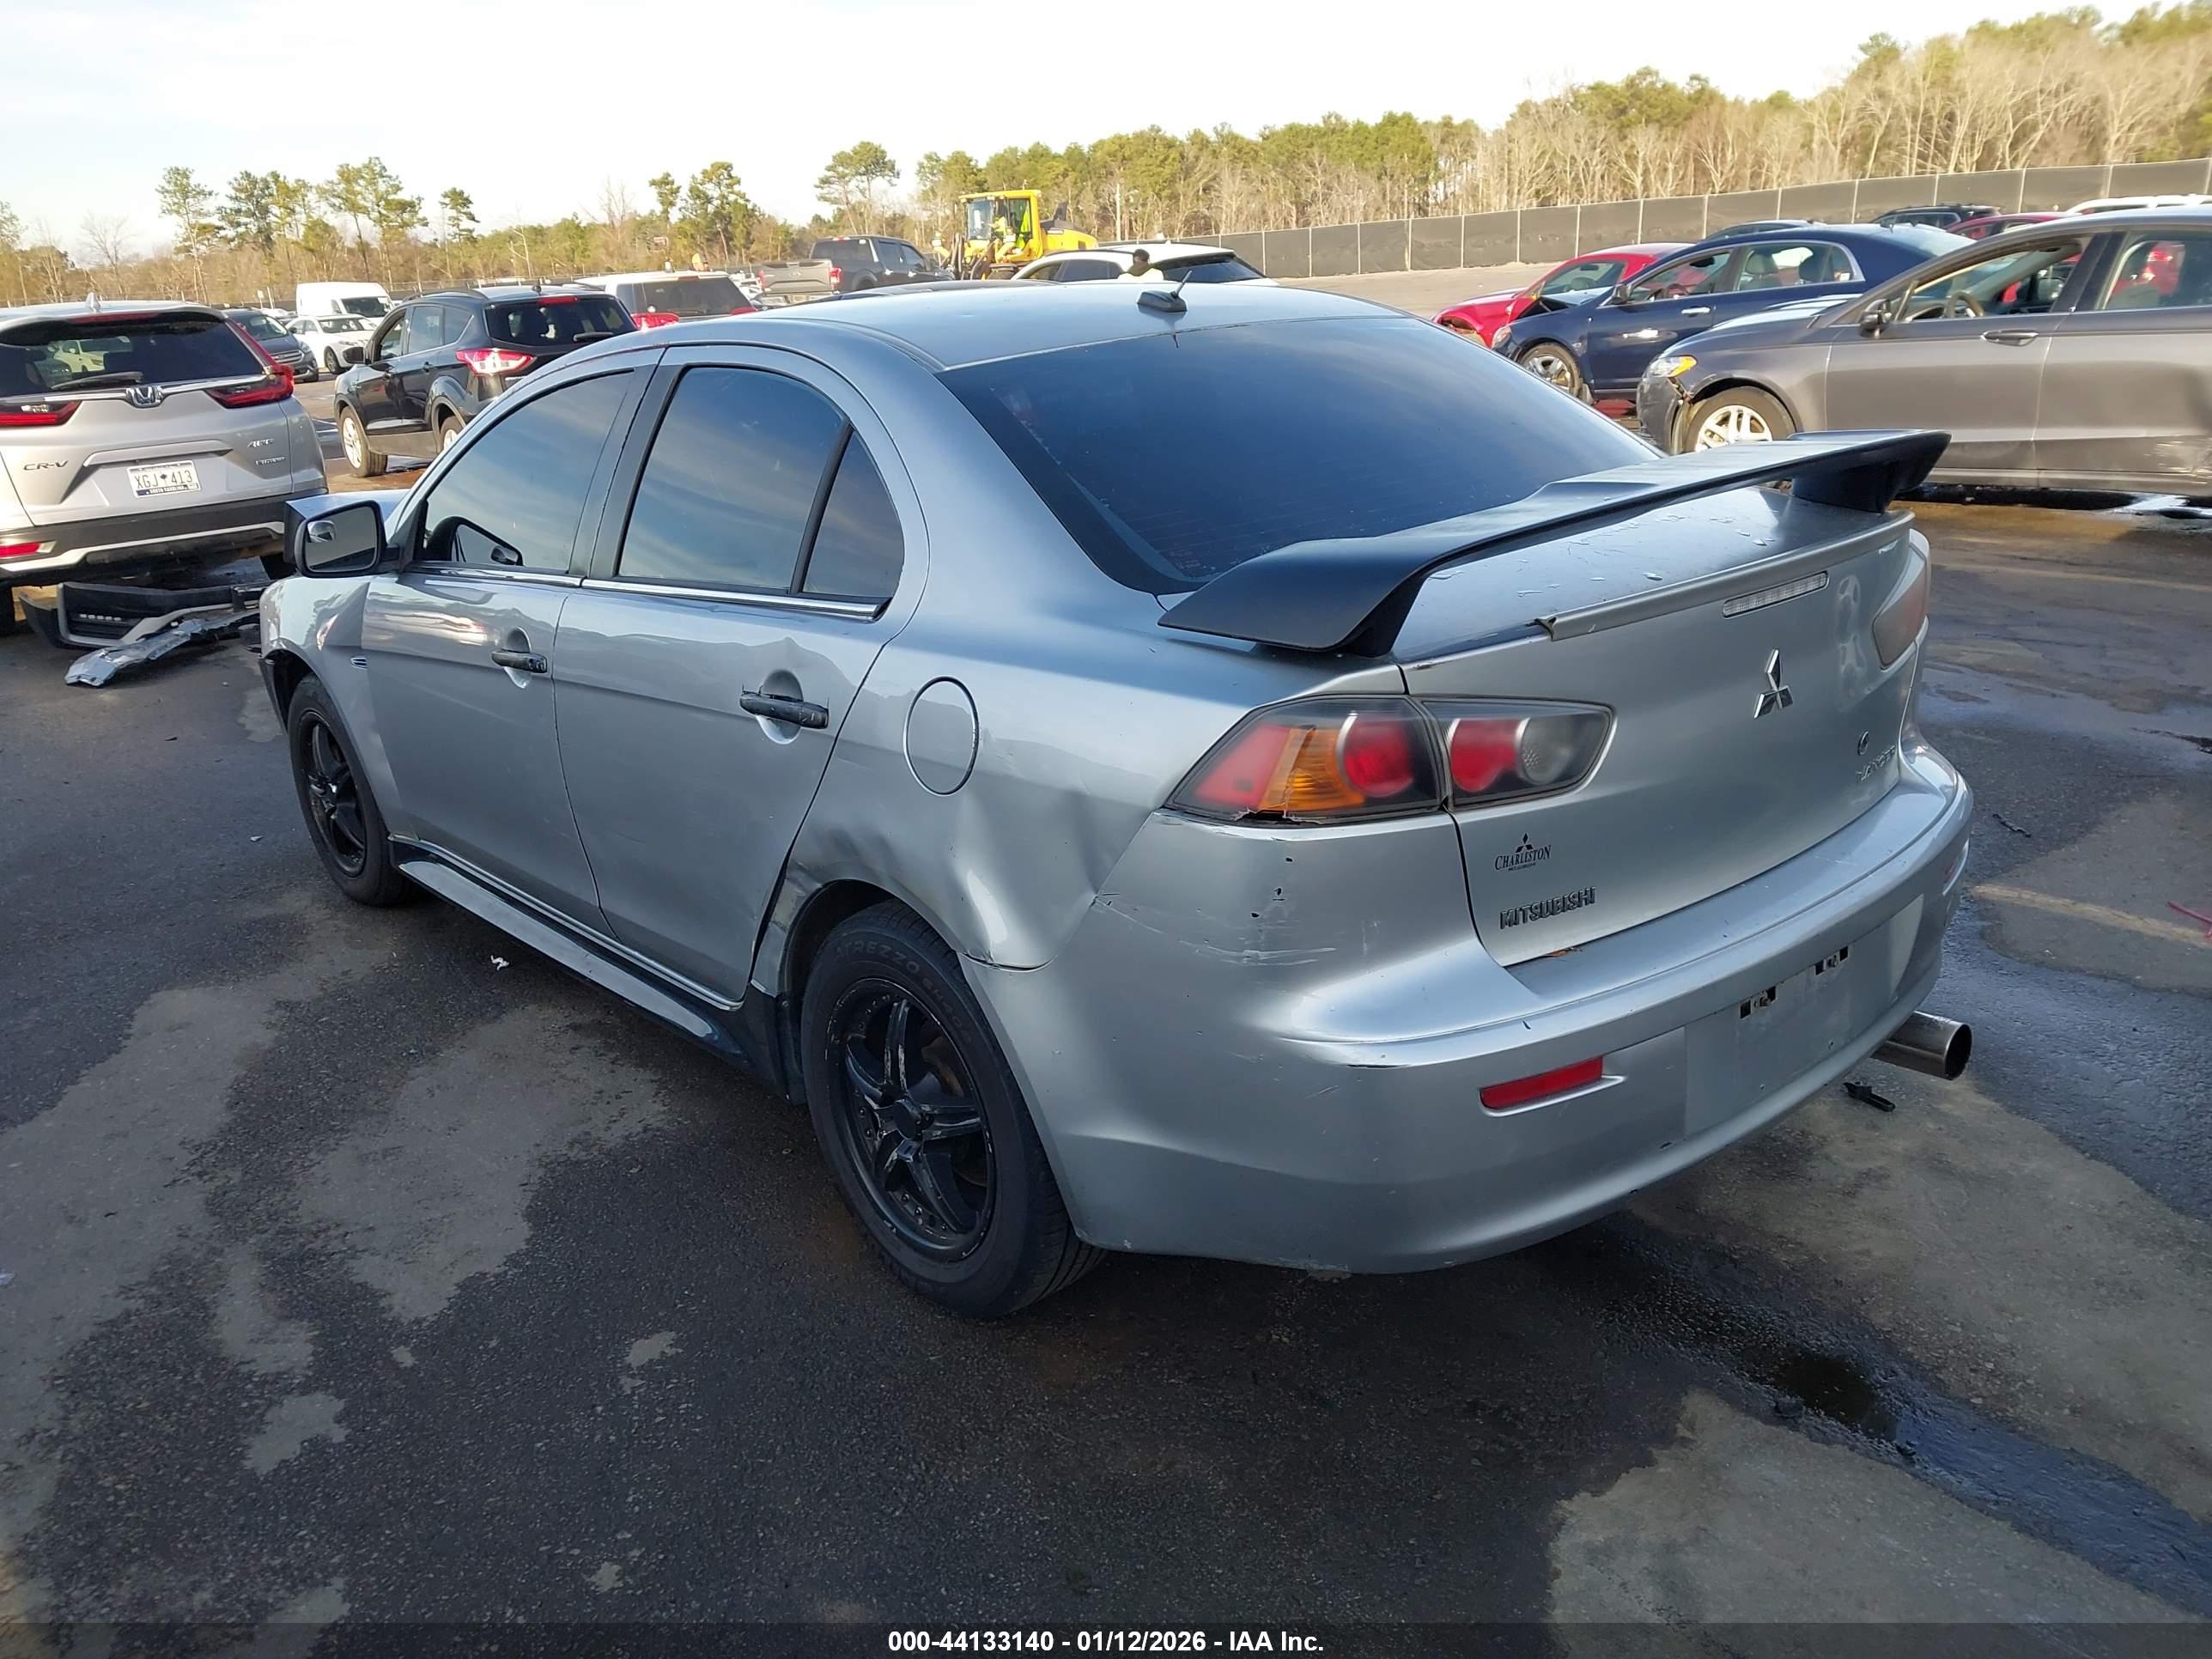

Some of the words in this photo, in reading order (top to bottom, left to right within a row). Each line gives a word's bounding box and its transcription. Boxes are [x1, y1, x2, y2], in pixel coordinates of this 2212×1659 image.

[23, 459, 69, 471] CR-V
[134, 473, 159, 489] XGJ
[170, 470, 193, 485] 413
[1495, 844, 1552, 871] CHARLESTON
[1500, 886, 1596, 929] MITSUBISHI
